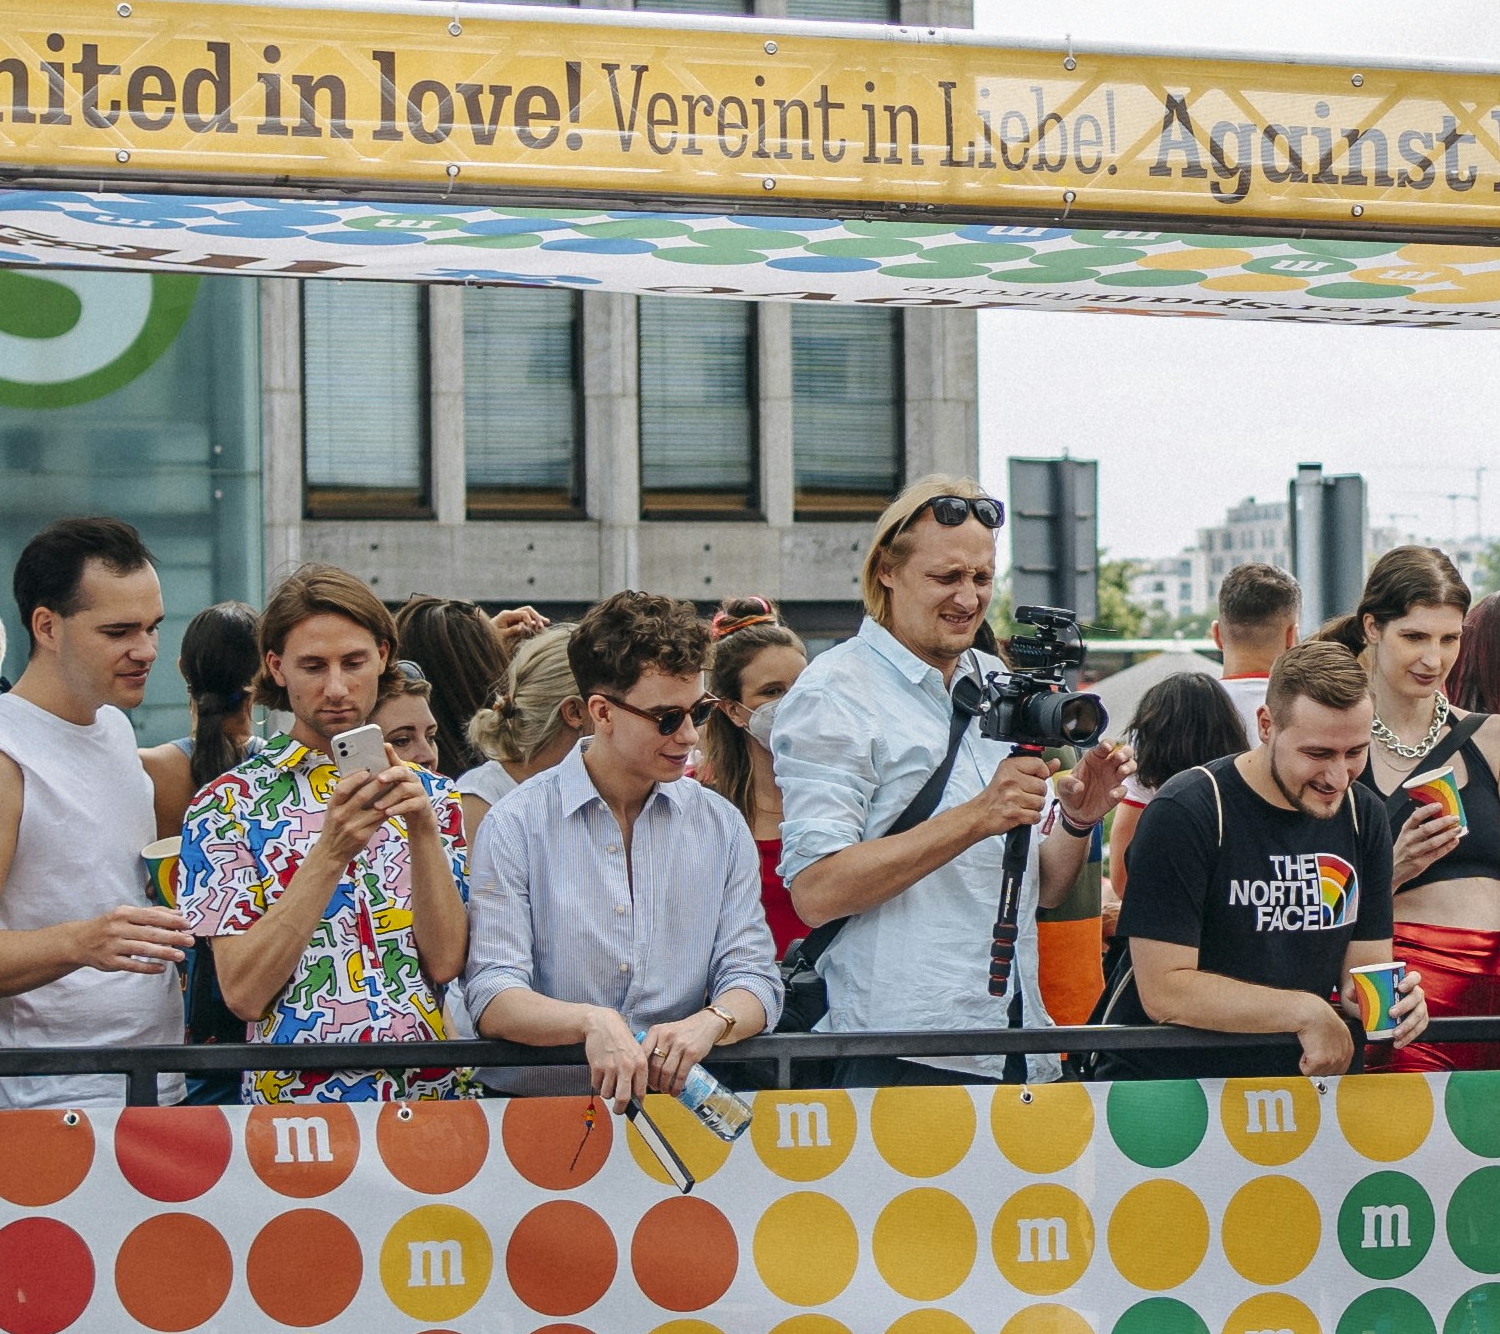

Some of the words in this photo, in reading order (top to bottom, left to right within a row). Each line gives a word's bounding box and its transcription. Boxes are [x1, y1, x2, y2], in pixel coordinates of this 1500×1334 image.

[260, 43, 353, 141] in
[368, 50, 586, 153] love!
[603, 62, 847, 164] Vereint
[860, 73, 924, 169] in
[937, 80, 1120, 177] Liebe!
[1149, 93, 1481, 204] Against
[1269, 854, 1317, 880] THE
[1229, 879, 1319, 906] NORTH
[1256, 905, 1319, 931] FACE
[272, 1117, 333, 1163] m
[775, 1102, 831, 1148] m
[1244, 1089, 1297, 1133] m
[408, 1240, 465, 1287] m
[1017, 1217, 1069, 1262] m
[1361, 1205, 1411, 1248] m
